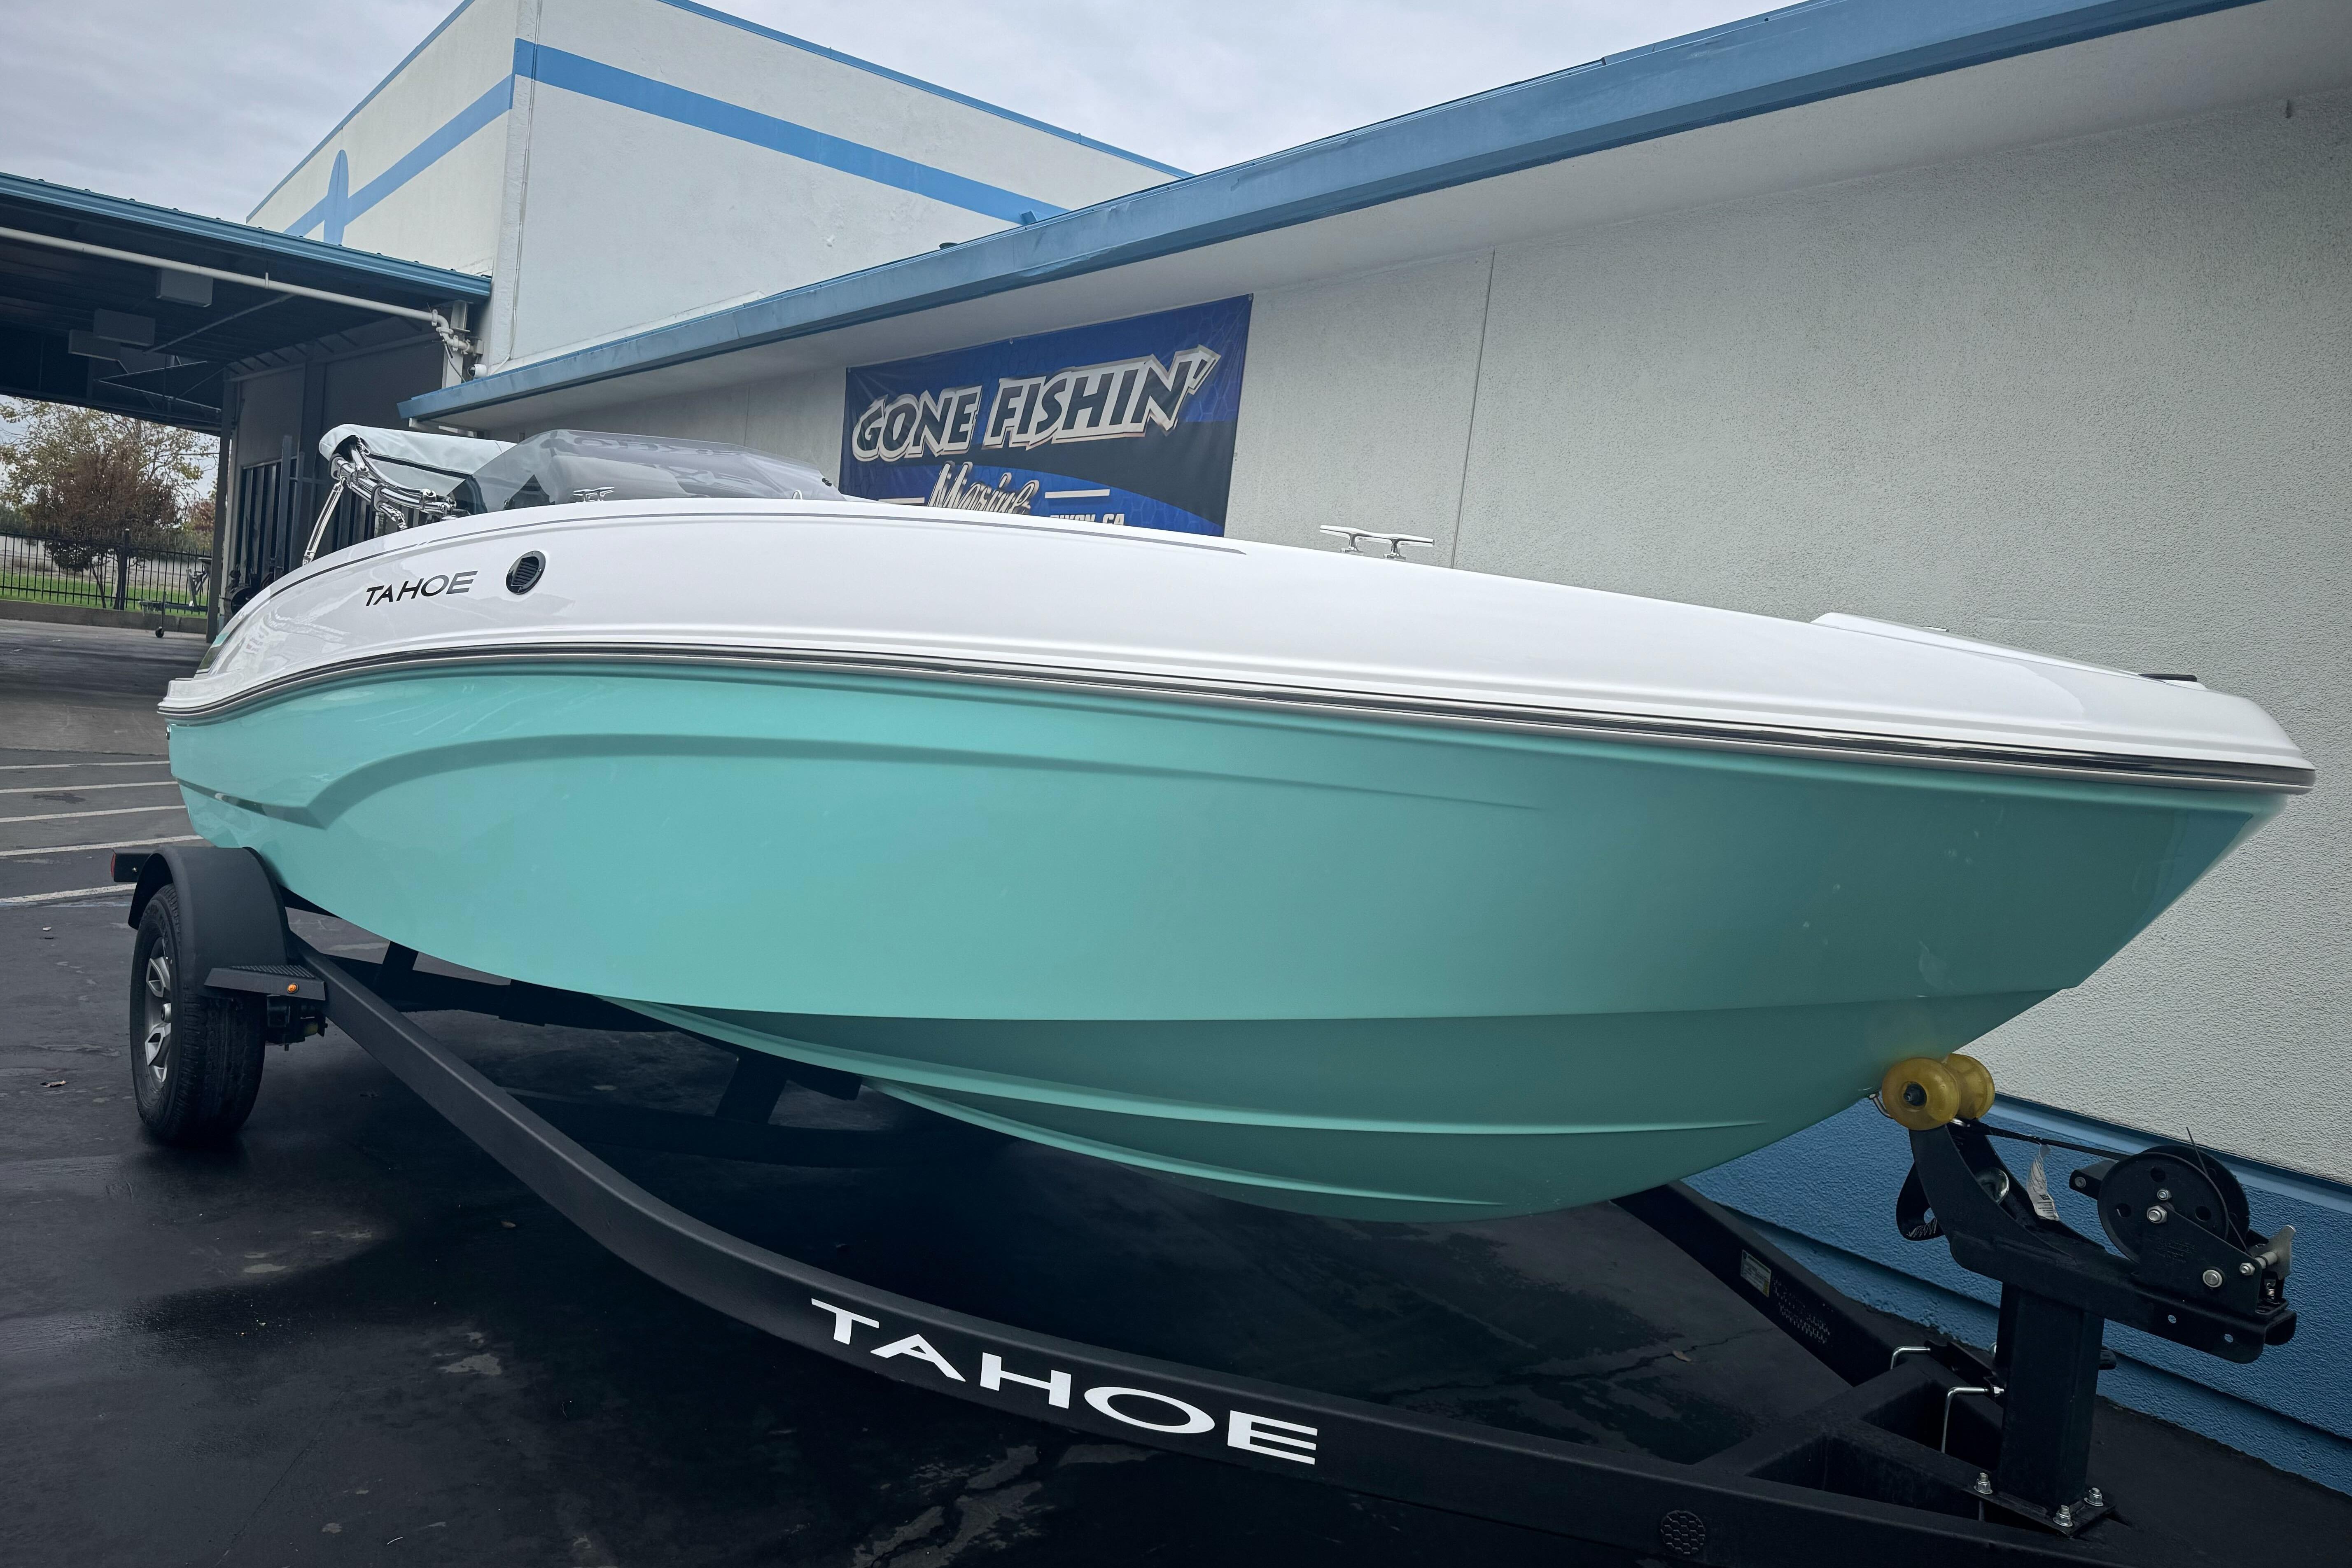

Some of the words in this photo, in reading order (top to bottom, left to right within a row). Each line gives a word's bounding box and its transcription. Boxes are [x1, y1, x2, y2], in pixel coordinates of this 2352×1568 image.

[852, 385, 982, 462] GONE
[984, 346, 1220, 449] FISHIN'
[366, 570, 478, 607] TAHOE
[811, 1298, 1318, 1465] TAHOE
